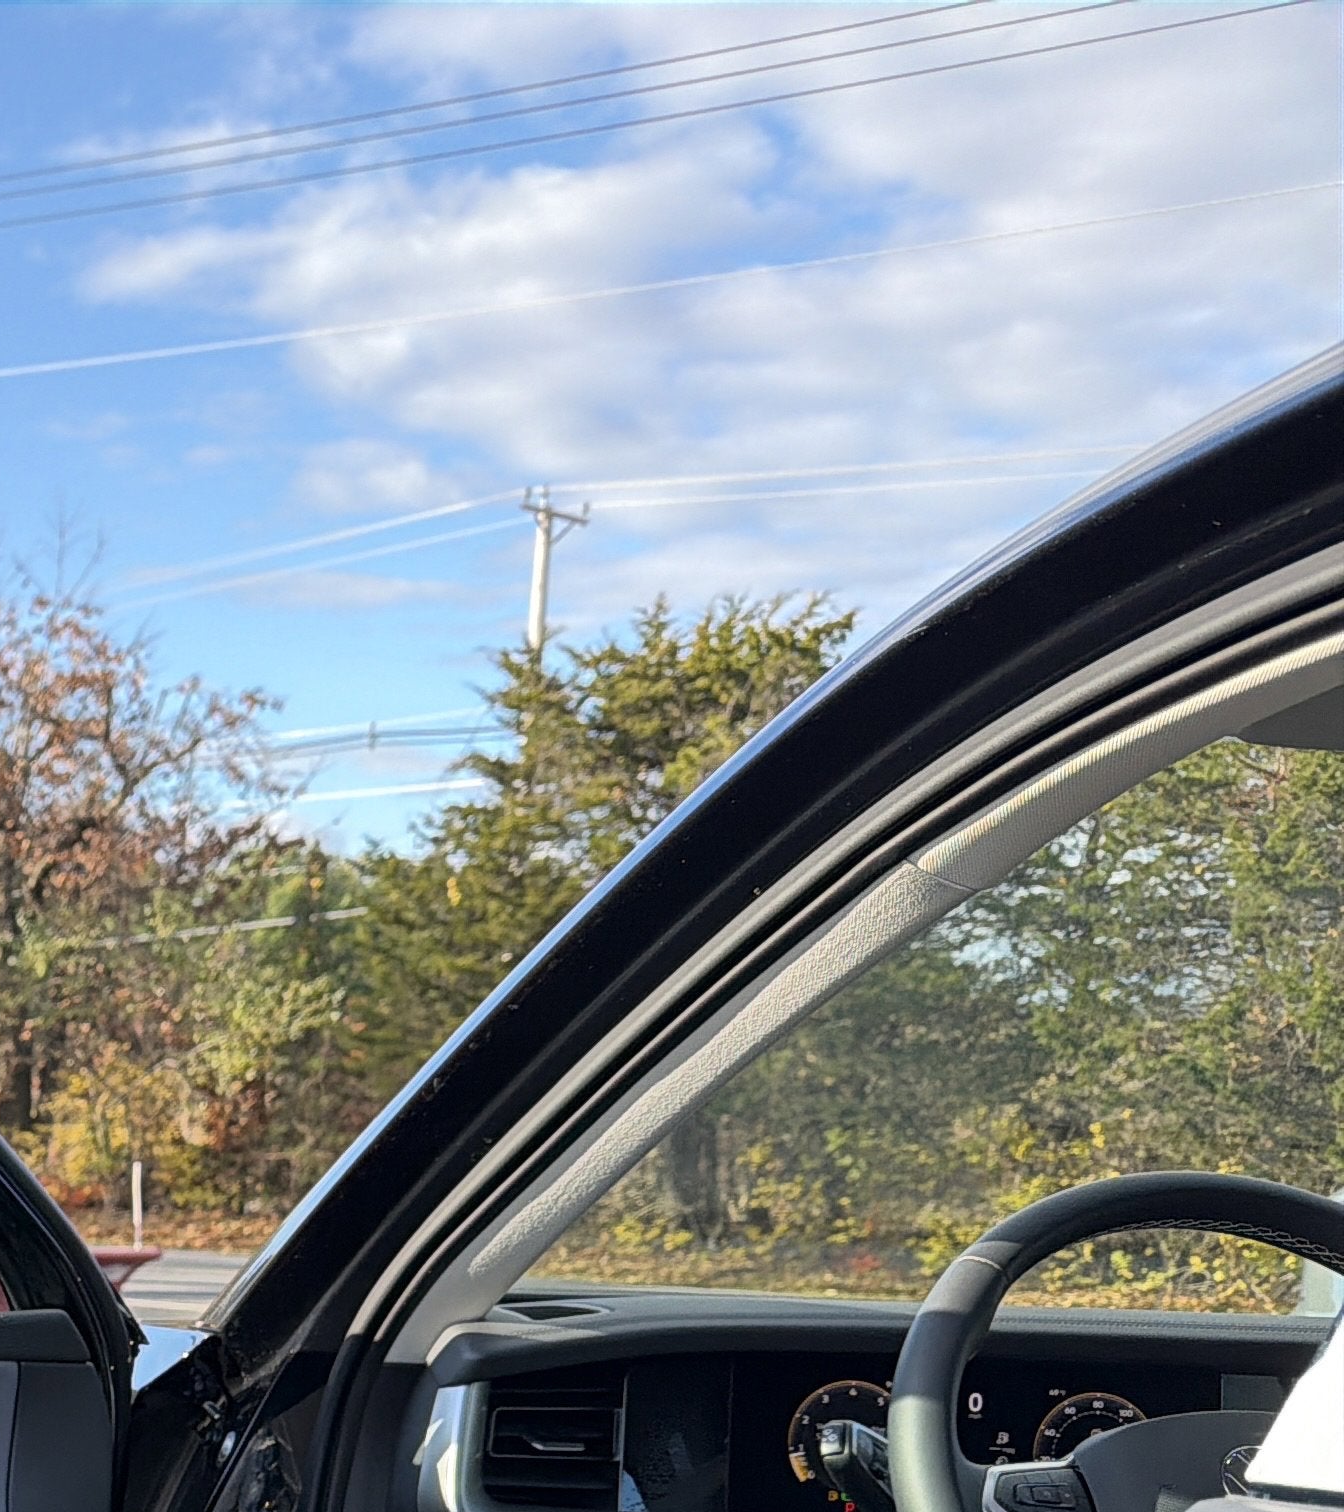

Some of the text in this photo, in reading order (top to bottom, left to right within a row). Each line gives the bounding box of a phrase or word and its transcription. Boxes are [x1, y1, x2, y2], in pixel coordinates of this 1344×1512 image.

[849, 1388, 858, 1396] 4
[822, 1395, 830, 1403] 3
[877, 1396, 885, 1406] 5
[968, 1392, 983, 1412] 0
[1064, 1406, 1076, 1415] 60
[1118, 1409, 1134, 1417] 100
[802, 1415, 810, 1424] 2
[1044, 1428, 1056, 1436] 40
